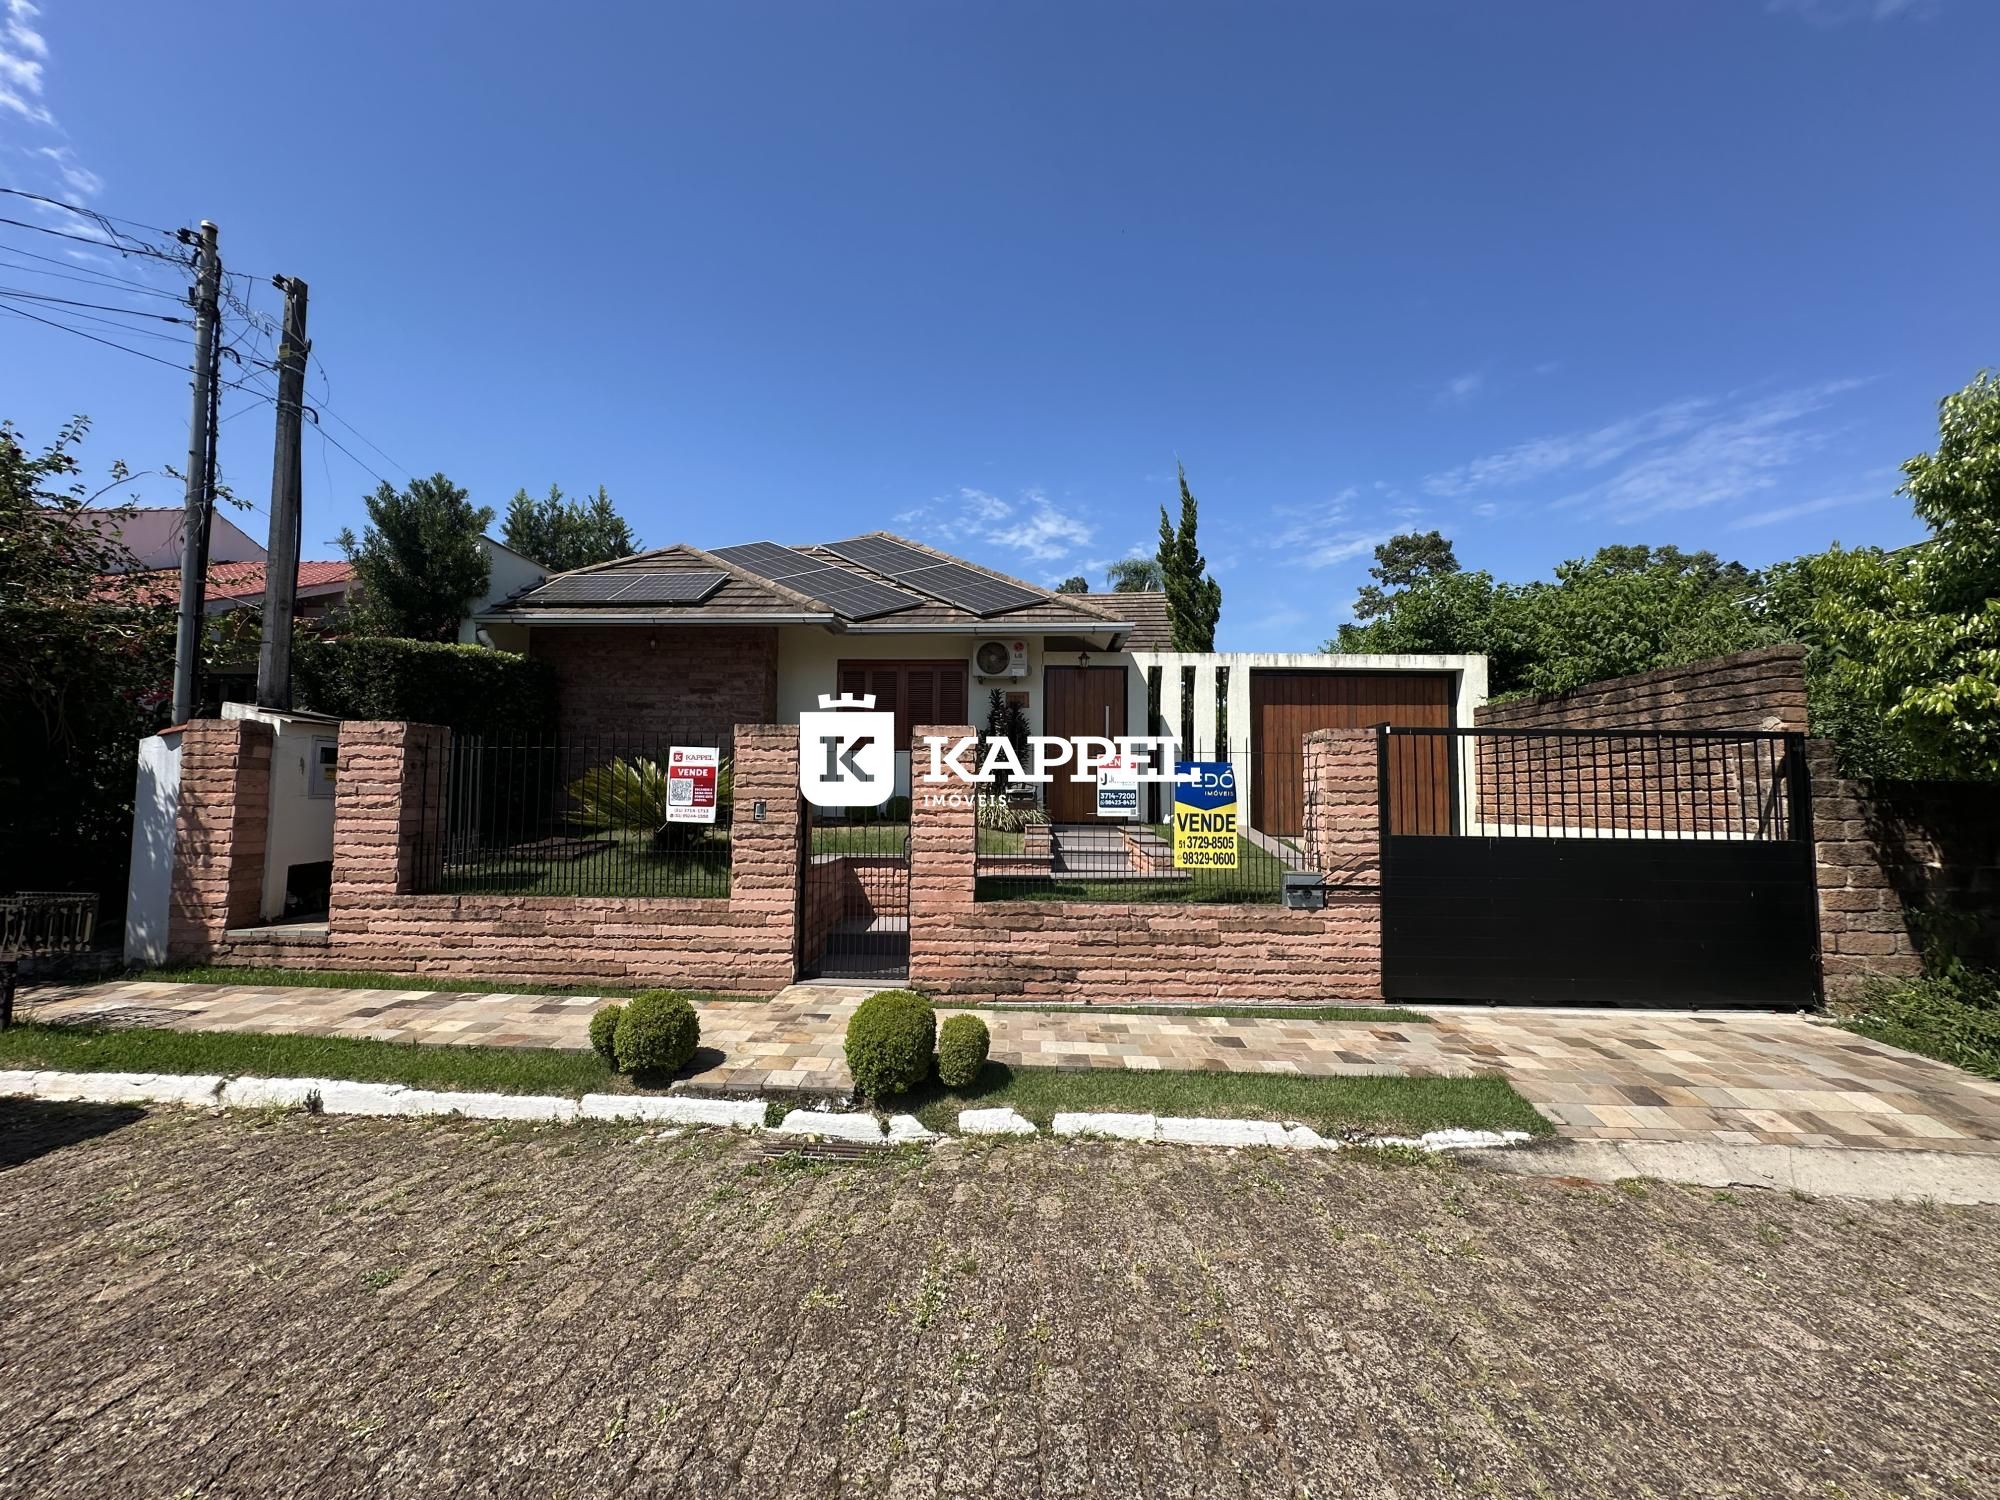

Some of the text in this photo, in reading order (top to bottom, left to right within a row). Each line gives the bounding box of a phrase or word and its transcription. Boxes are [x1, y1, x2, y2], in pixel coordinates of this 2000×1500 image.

[677, 768, 709, 777] VENDE
[1100, 792, 1136, 800] 3714-7200
[1176, 813, 1236, 833] VENDE
[1178, 835, 1234, 849] 51 3729-8505
[1182, 851, 1236, 866] 98329-0600
